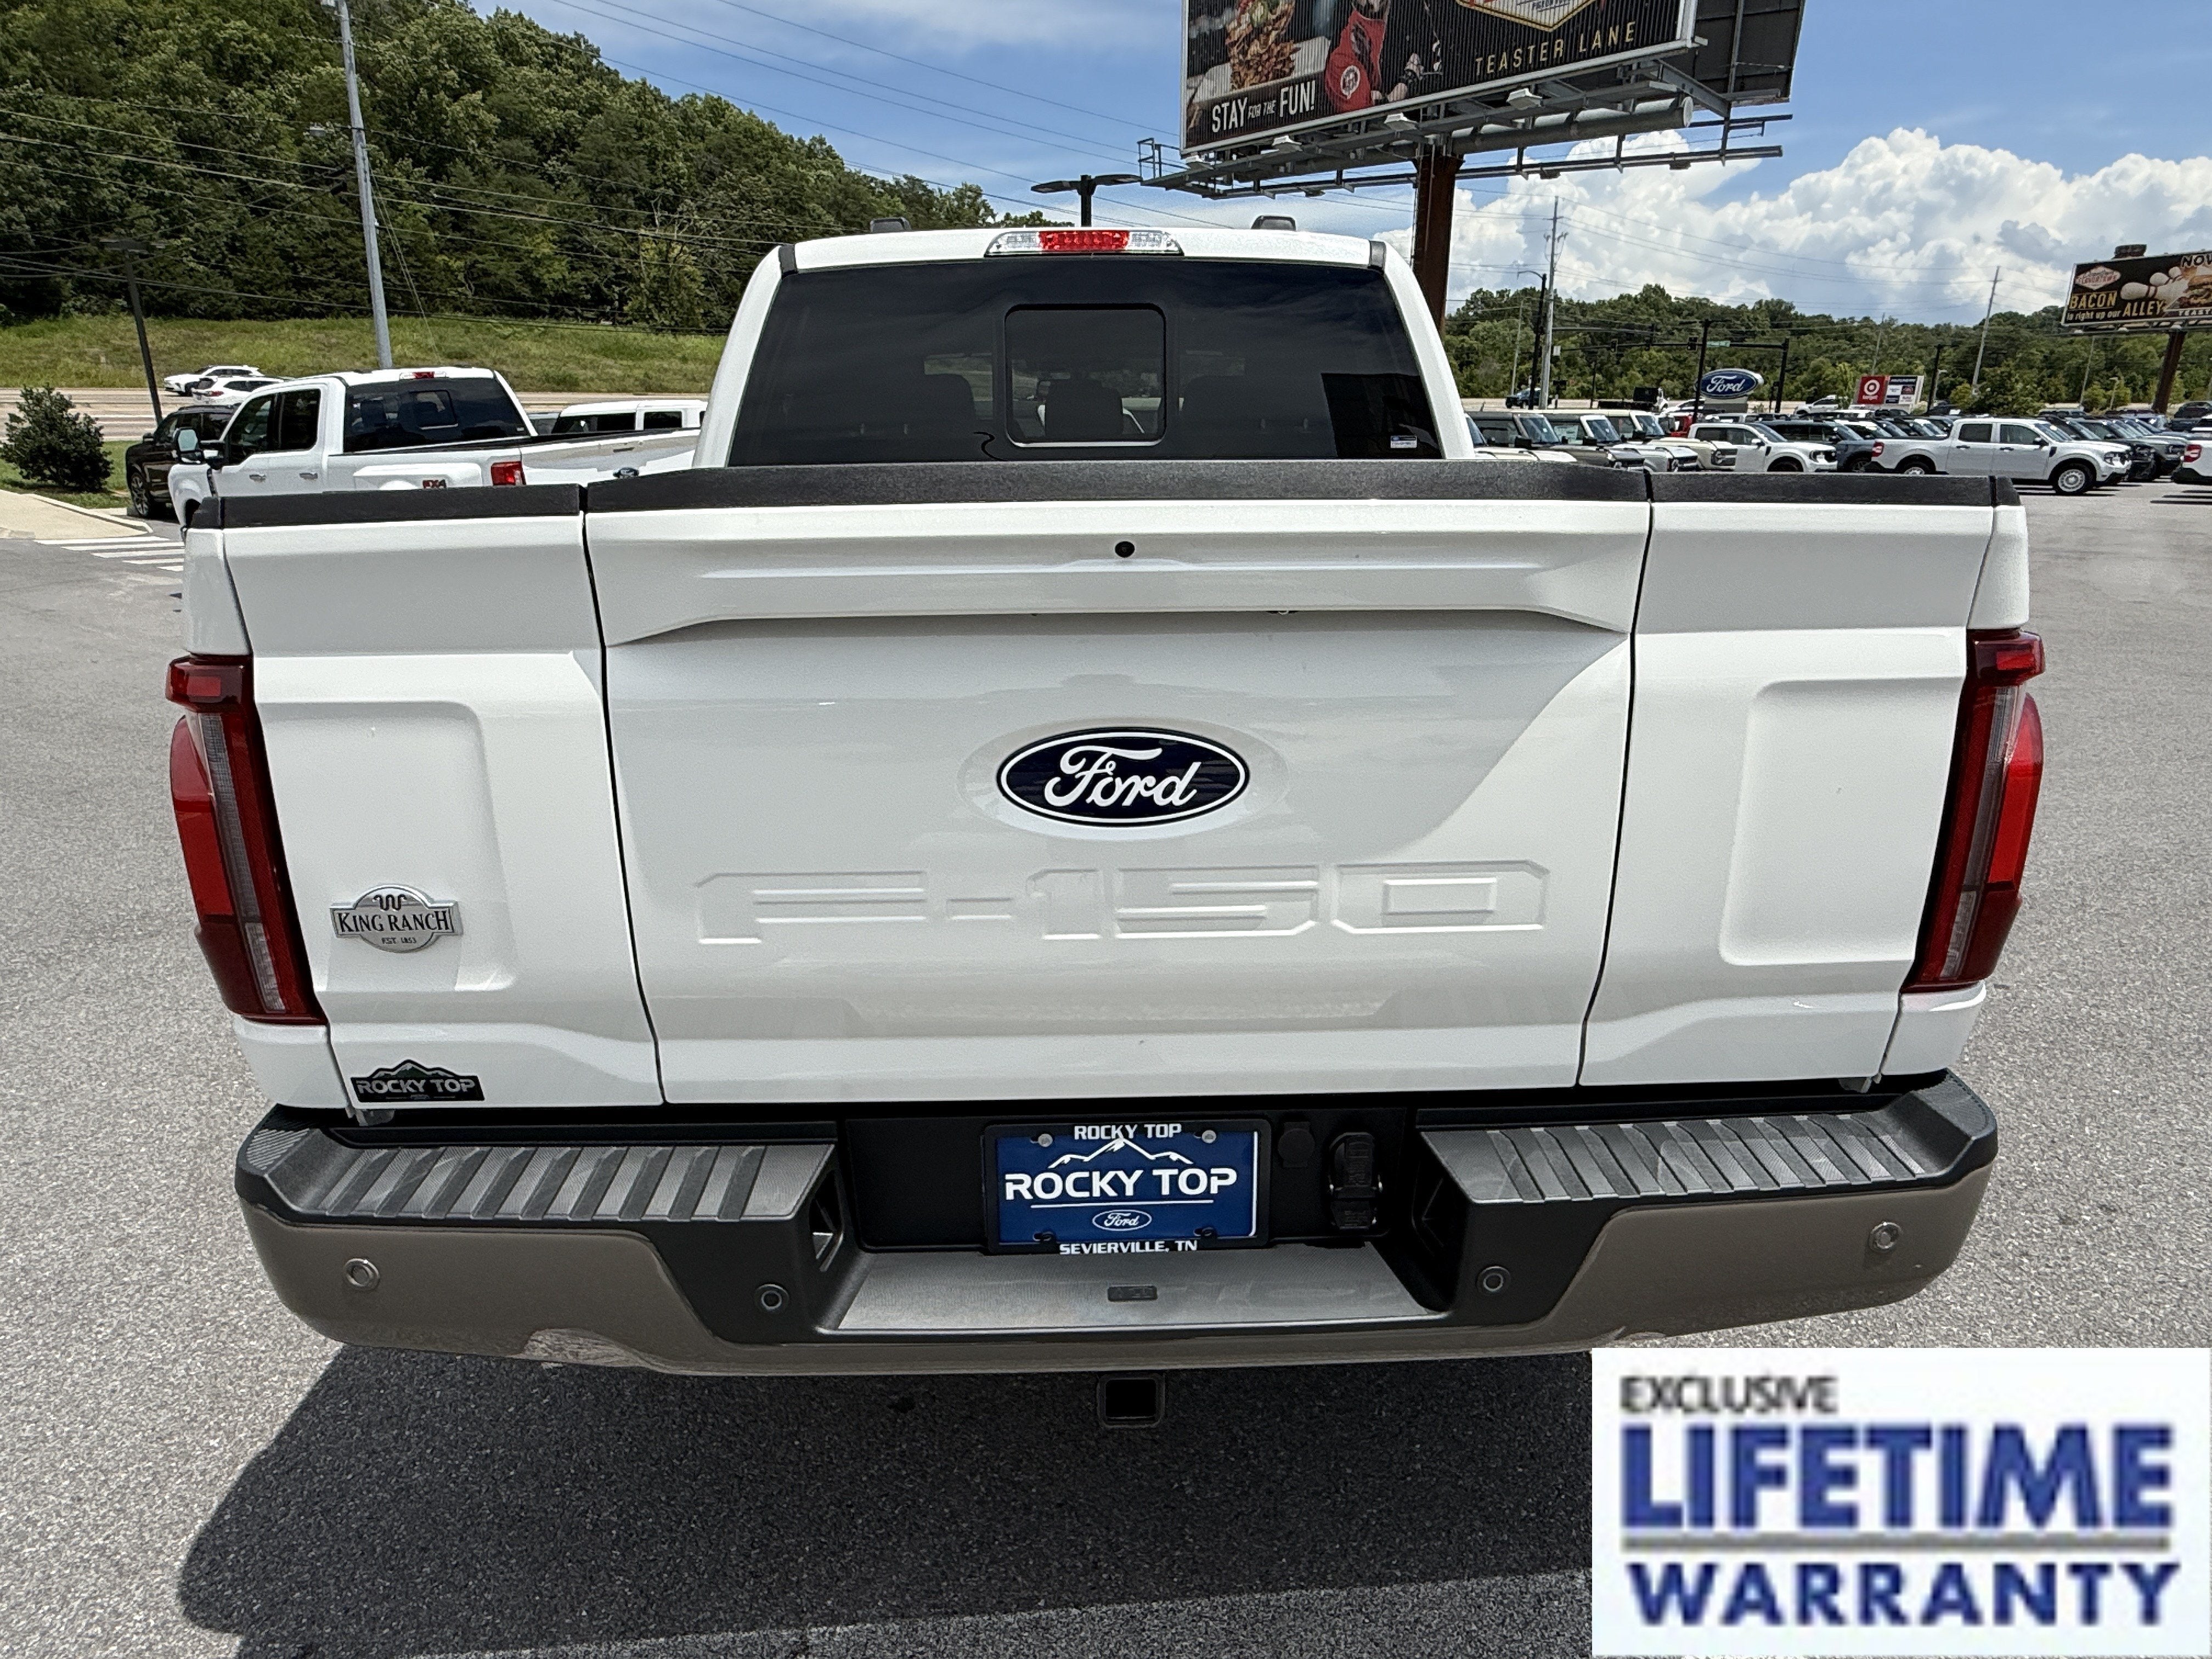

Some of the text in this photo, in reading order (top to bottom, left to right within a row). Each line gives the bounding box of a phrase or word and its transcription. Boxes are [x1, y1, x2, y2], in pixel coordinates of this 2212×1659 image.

[1475, 21, 1636, 76] TEASTER LANE
[1211, 97, 1248, 133] STAY
[1279, 80, 1316, 117] FUN!
[2070, 292, 2117, 309] BACON
[2075, 311, 2094, 321] right
[2096, 312, 2106, 320] up
[2122, 301, 2164, 317] ALLEY
[1706, 375, 1746, 392] Ford
[1044, 745, 1202, 807] Ford
[695, 859, 1550, 945] F-150
[337, 910, 450, 933] KING RANCH
[356, 1079, 475, 1094] ROCKY TOP
[1074, 1124, 1182, 1141] ROCKY TOP
[1005, 1167, 1238, 1201] ROCKY TOP
[1104, 1212, 1140, 1227] Ford
[1059, 1240, 1198, 1255] SEVIERVILLE, TN
